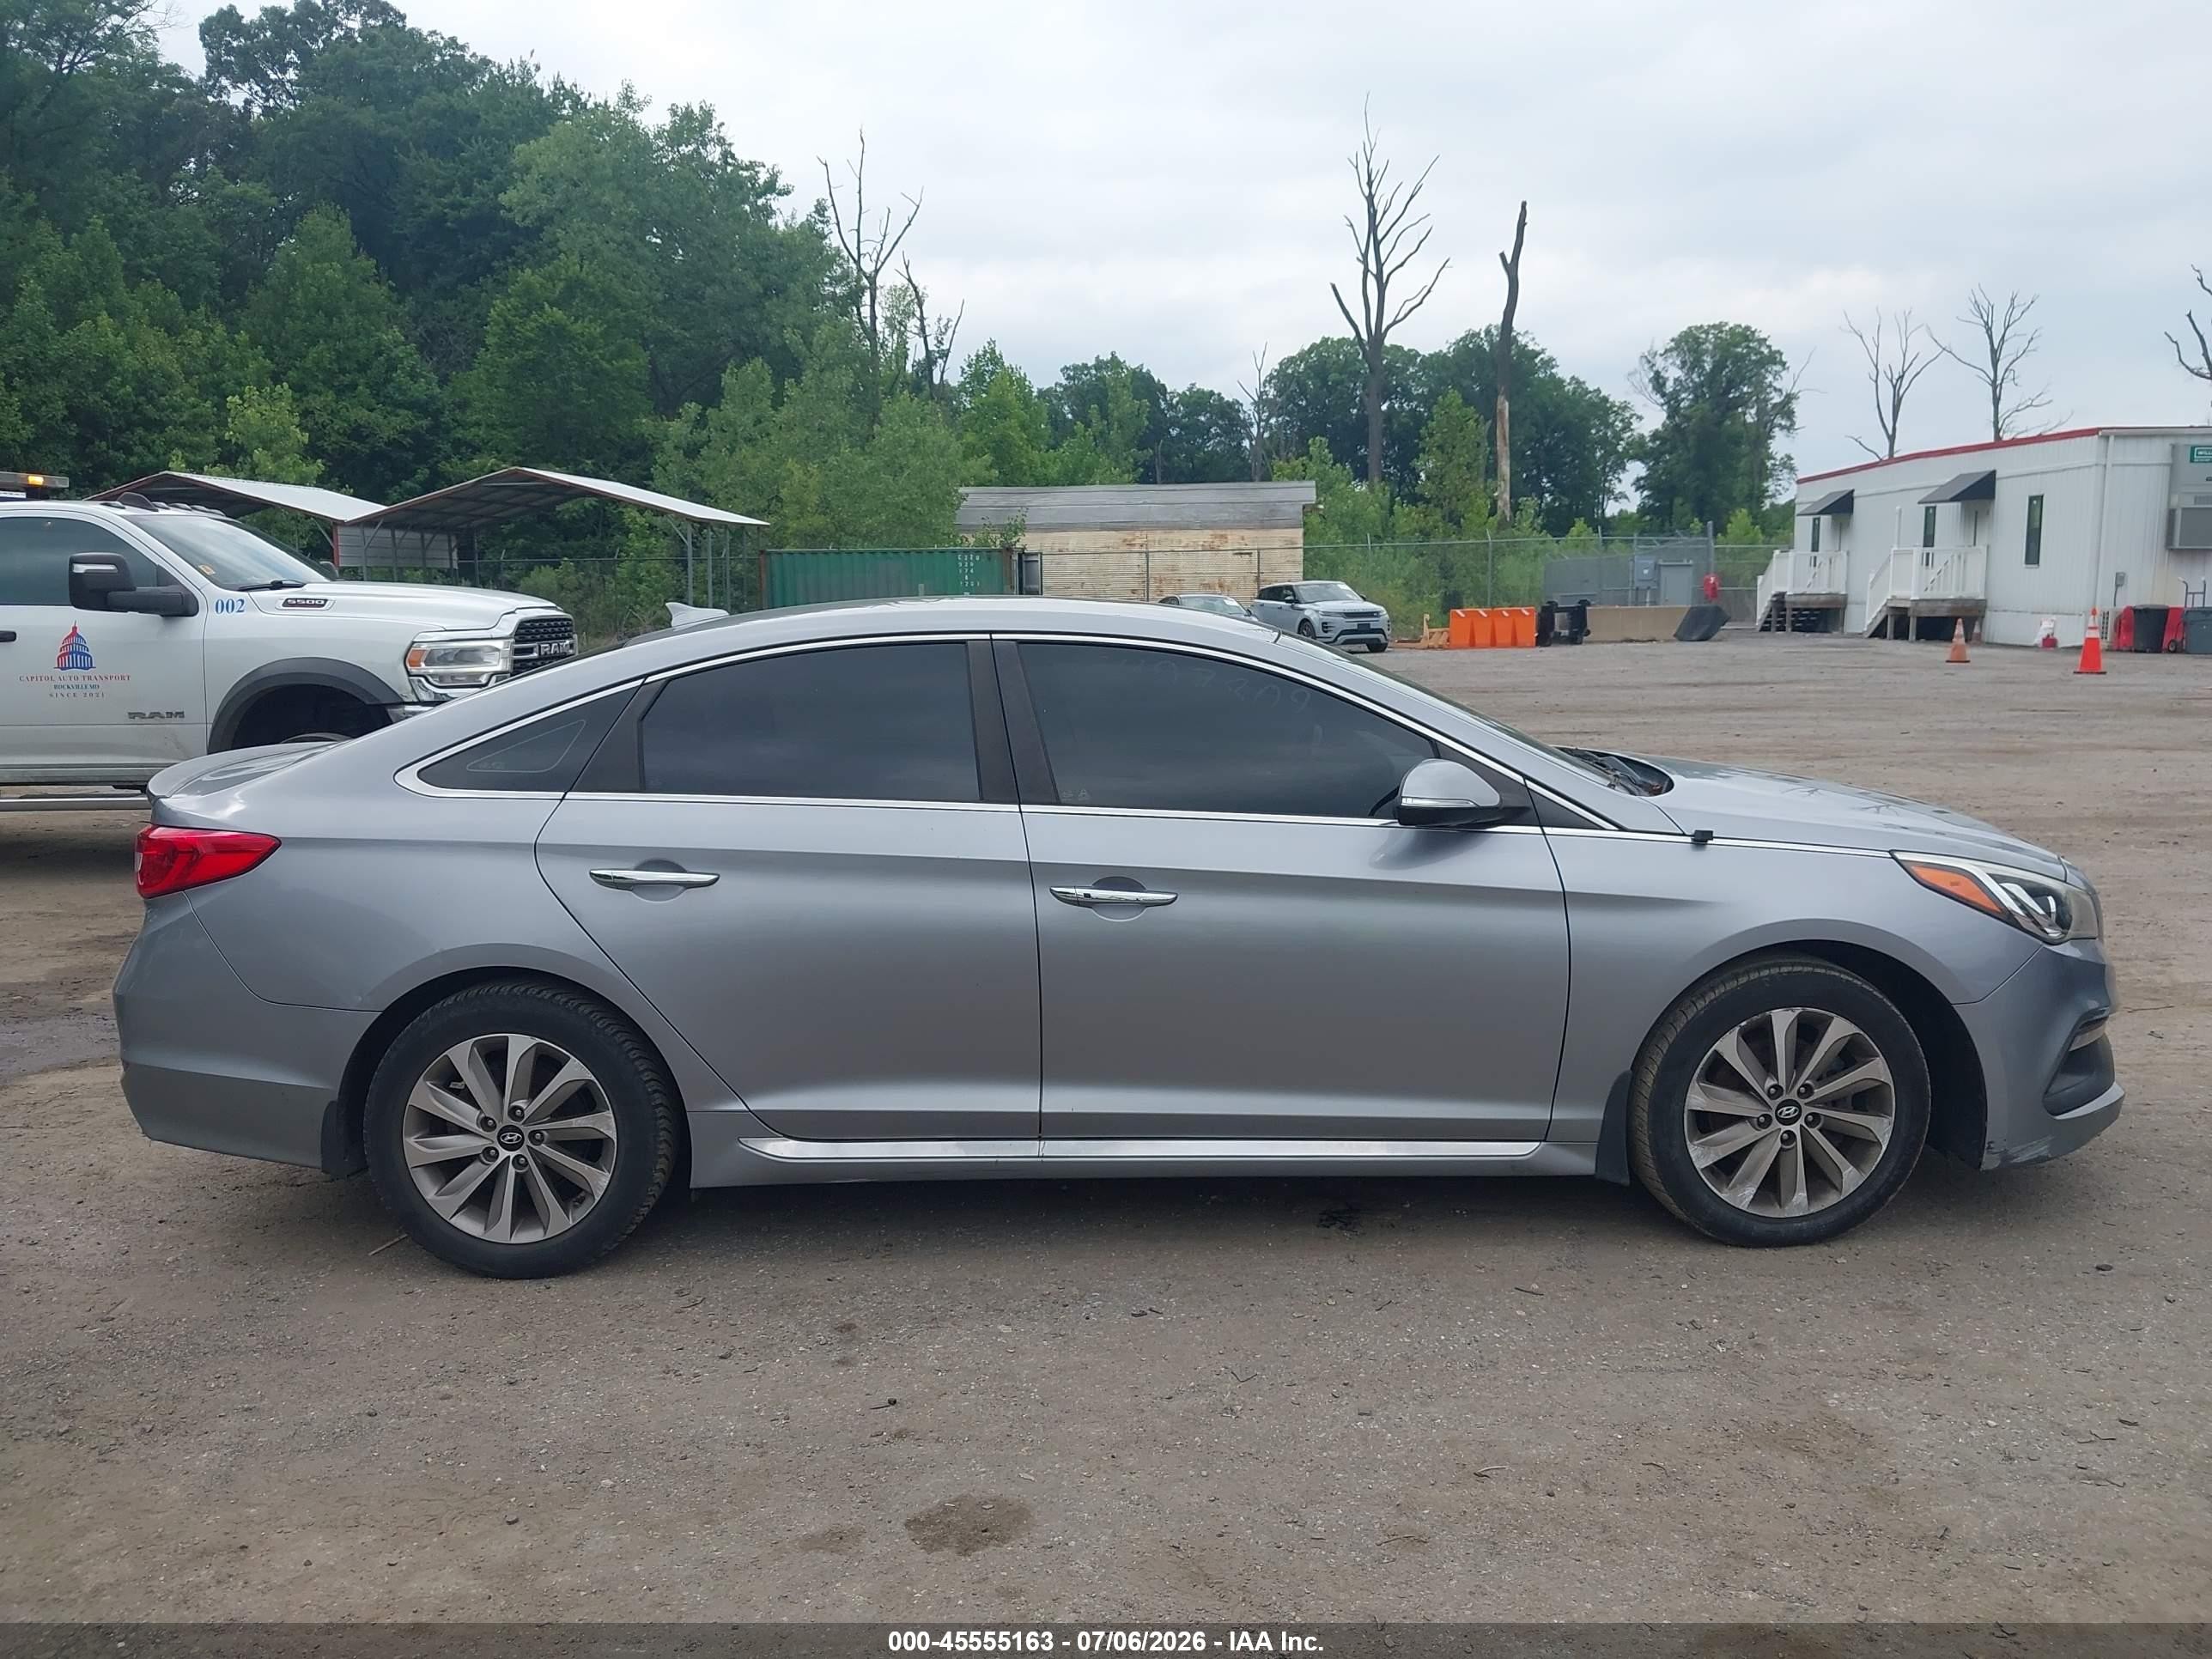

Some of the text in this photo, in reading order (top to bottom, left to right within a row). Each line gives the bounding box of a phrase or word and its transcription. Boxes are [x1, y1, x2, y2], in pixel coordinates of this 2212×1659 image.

[215, 599, 245, 614] 002
[539, 641, 573, 656] RAM
[127, 711, 185, 720] RAM
